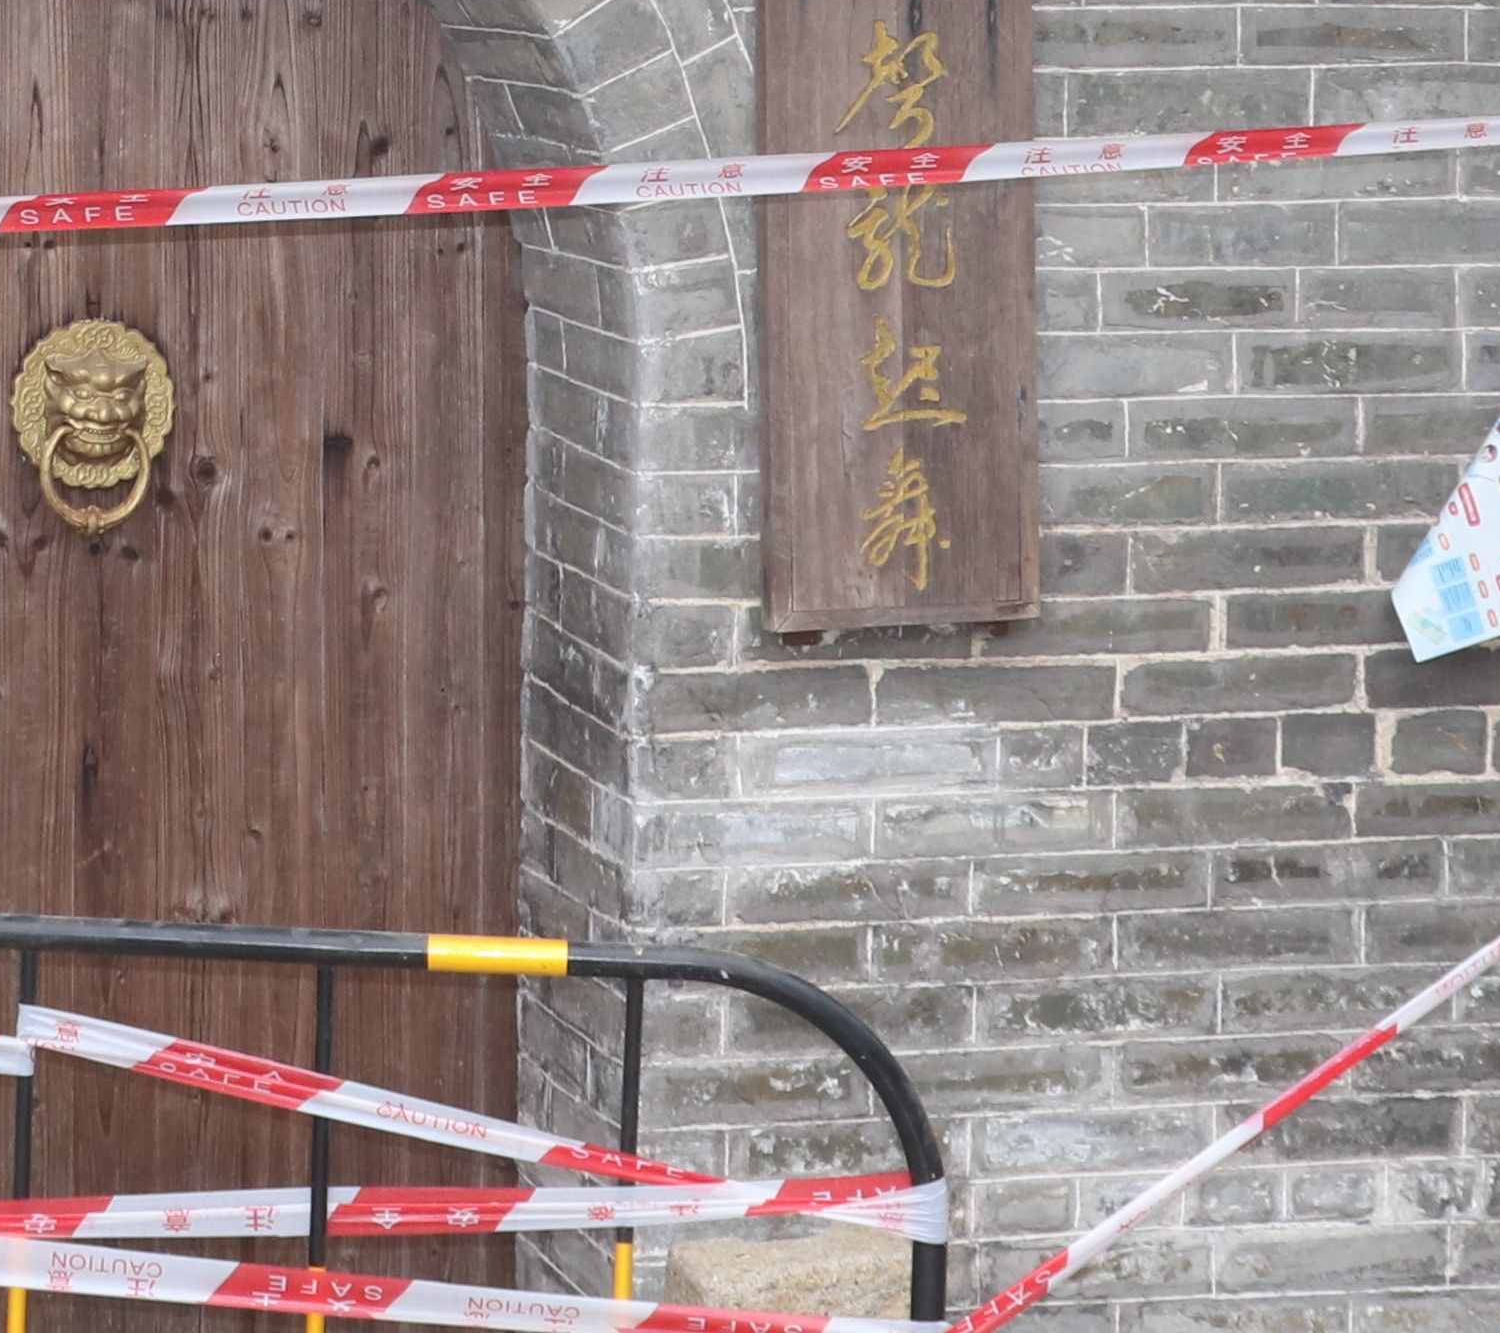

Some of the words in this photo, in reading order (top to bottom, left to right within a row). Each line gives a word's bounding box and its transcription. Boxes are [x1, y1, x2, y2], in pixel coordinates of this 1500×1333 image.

[841, 151, 940, 173] 安全
[635, 181, 743, 199] CAUTION
[819, 172, 927, 189] SAFE
[237, 196, 346, 217] CAUTION
[426, 189, 538, 210] SAFE
[19, 205, 136, 225] SAFE
[50, 1250, 163, 1280] CAUTION
[268, 1274, 383, 1302] SAFE
[466, 1295, 581, 1321] CAUTION
